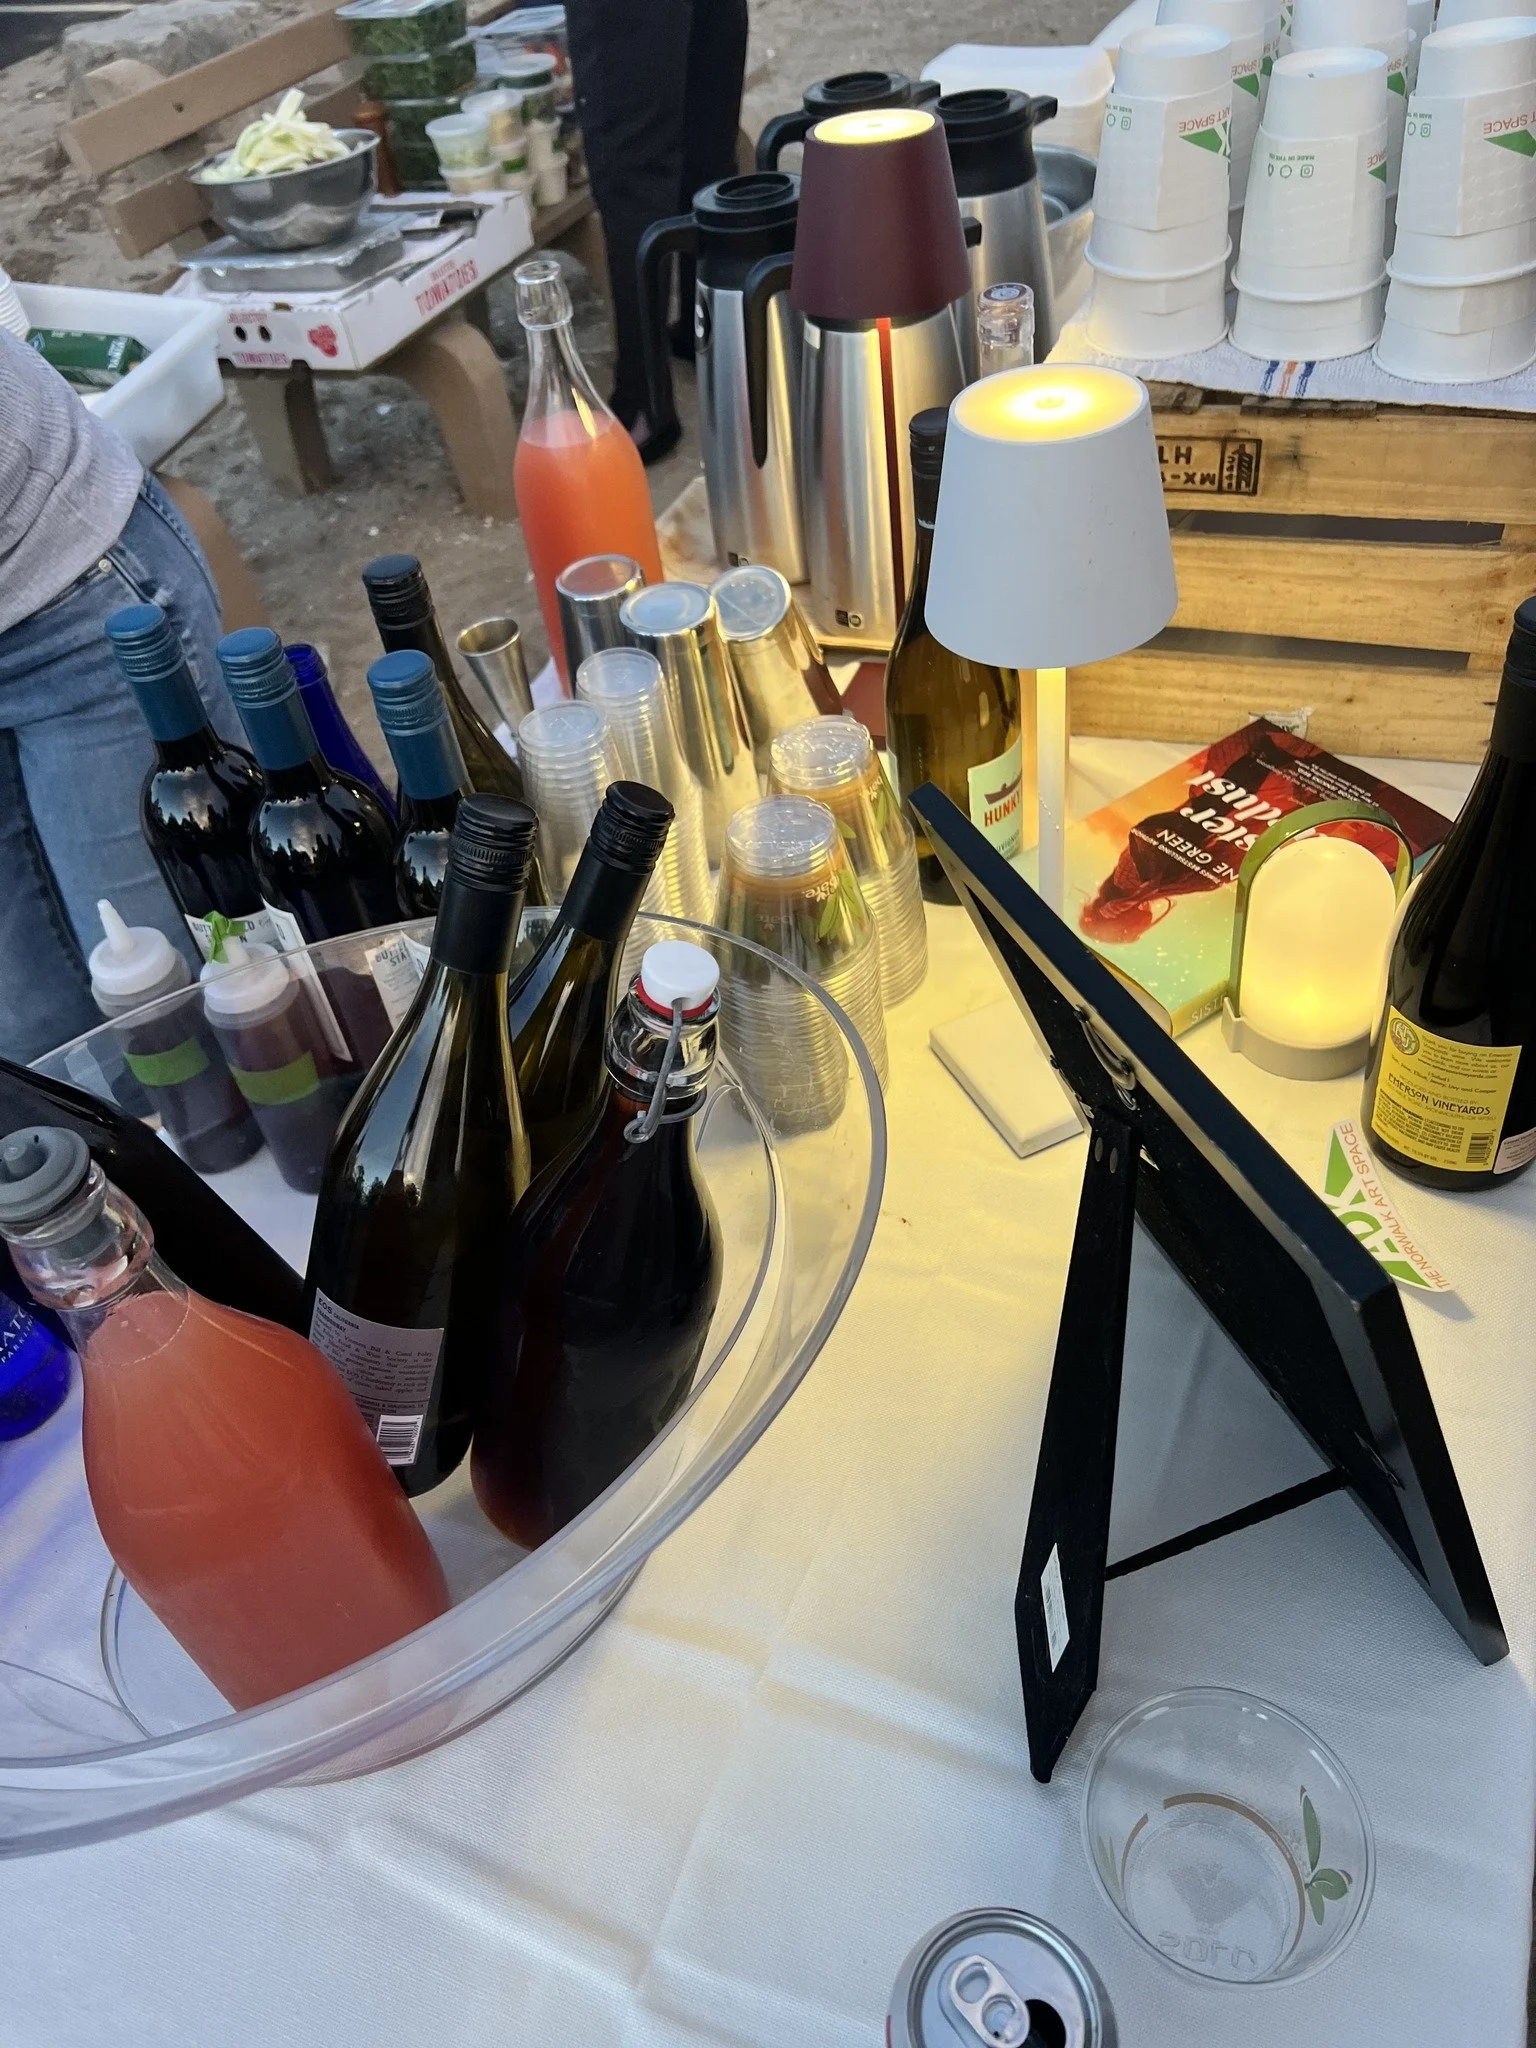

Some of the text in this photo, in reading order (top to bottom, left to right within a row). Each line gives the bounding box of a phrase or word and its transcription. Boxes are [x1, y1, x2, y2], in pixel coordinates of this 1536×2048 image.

[1178, 113, 1217, 133] SPACE
[1483, 114, 1528, 135] SPACE
[1184, 770, 1282, 827] dust
[1155, 828, 1213, 865] GREEN
[1388, 1072, 1430, 1104] EMERSON
[1432, 1097, 1491, 1115] VINEYARDS
[1340, 1122, 1451, 1289] THE NORWALK ART SPACE
[318, 1297, 333, 1314] EOS
